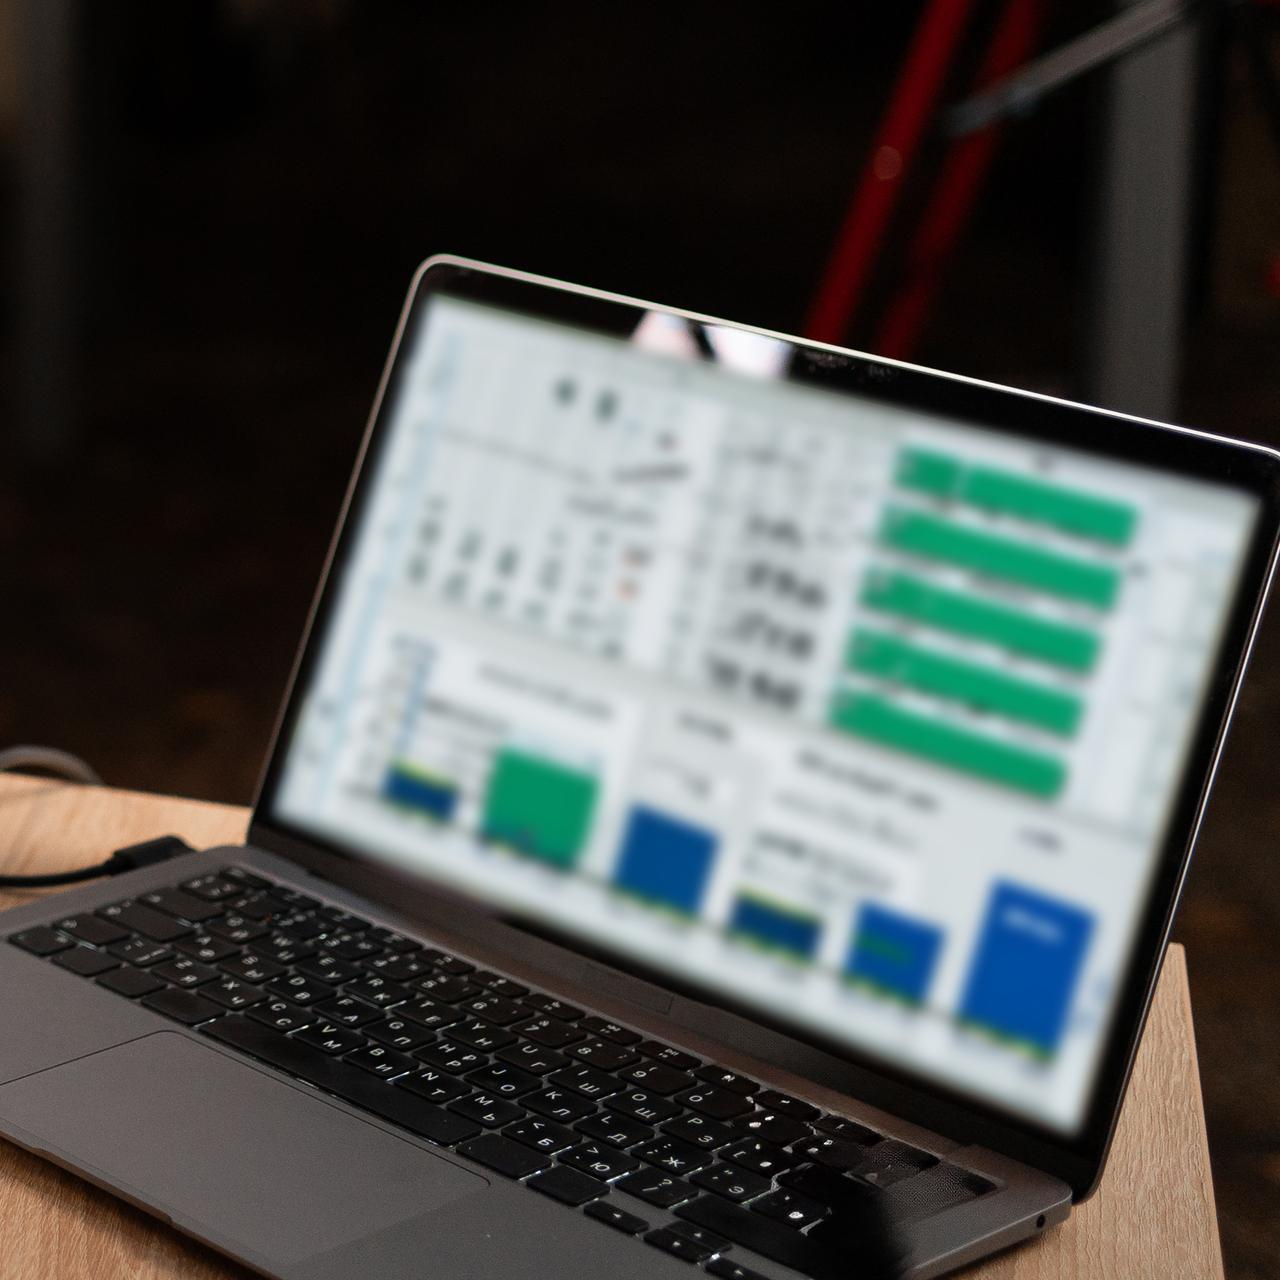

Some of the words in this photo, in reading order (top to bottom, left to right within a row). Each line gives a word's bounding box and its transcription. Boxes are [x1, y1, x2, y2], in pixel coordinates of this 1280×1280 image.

[419, 1000, 435, 1008] T
[322, 1025, 337, 1034] V
[471, 1022, 486, 1031] Y
[369, 1047, 385, 1057] B
[438, 1043, 456, 1053] H
[522, 1045, 538, 1054] U
[421, 1072, 440, 1082] N
[632, 1070, 647, 1078] 9
[544, 1090, 563, 1100] K
[474, 1095, 494, 1106] M
[600, 1115, 613, 1125] L
